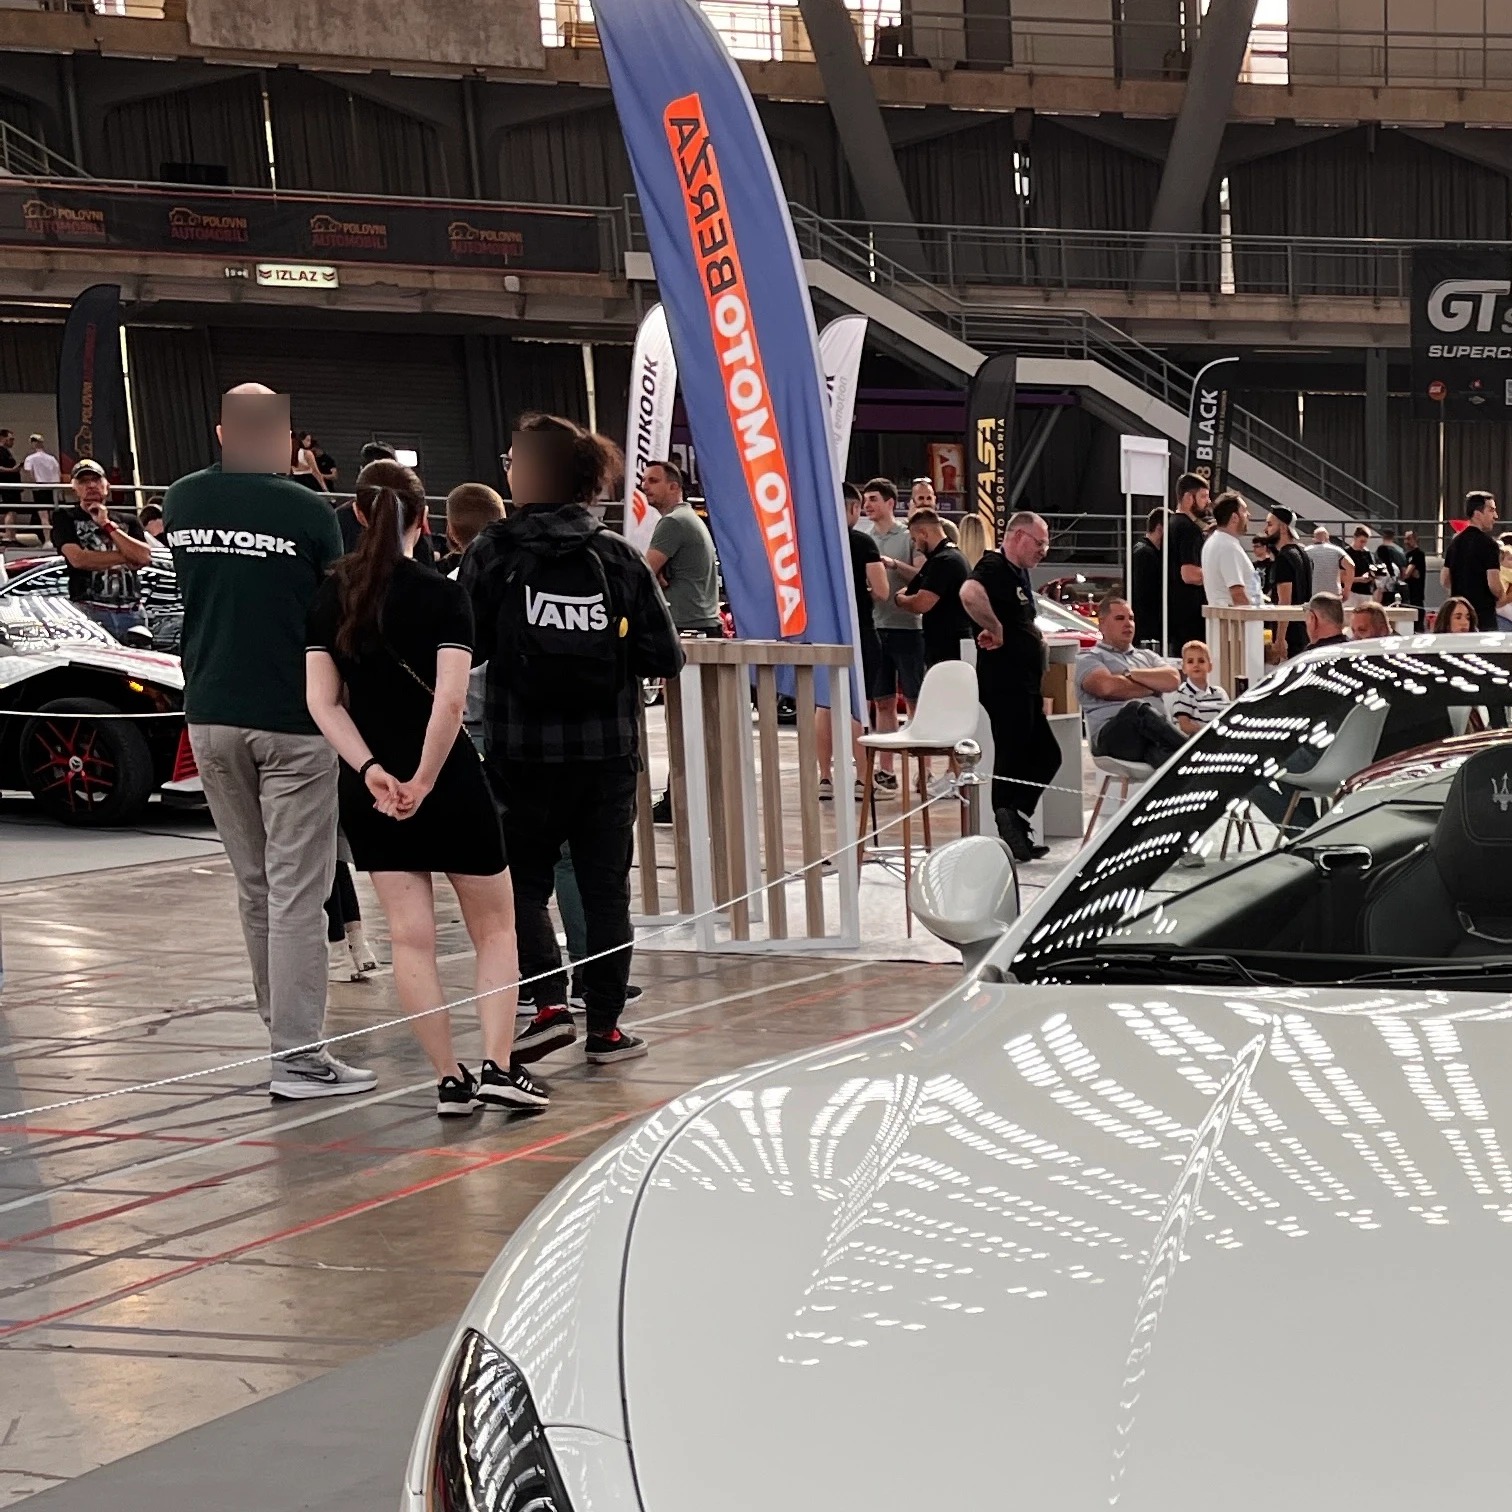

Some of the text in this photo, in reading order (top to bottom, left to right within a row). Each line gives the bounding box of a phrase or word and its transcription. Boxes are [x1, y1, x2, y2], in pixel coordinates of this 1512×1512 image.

[202, 216, 248, 228] POLOVNI
[275, 269, 318, 282] IZLAZ
[1427, 278, 1511, 332] GT
[997, 418, 1005, 462] ADRIA
[1196, 389, 1218, 460] BLACK
[996, 467, 1005, 512] SPORT
[166, 528, 214, 548] NEW
[216, 529, 297, 556] YORK
[524, 584, 609, 631] VANS
